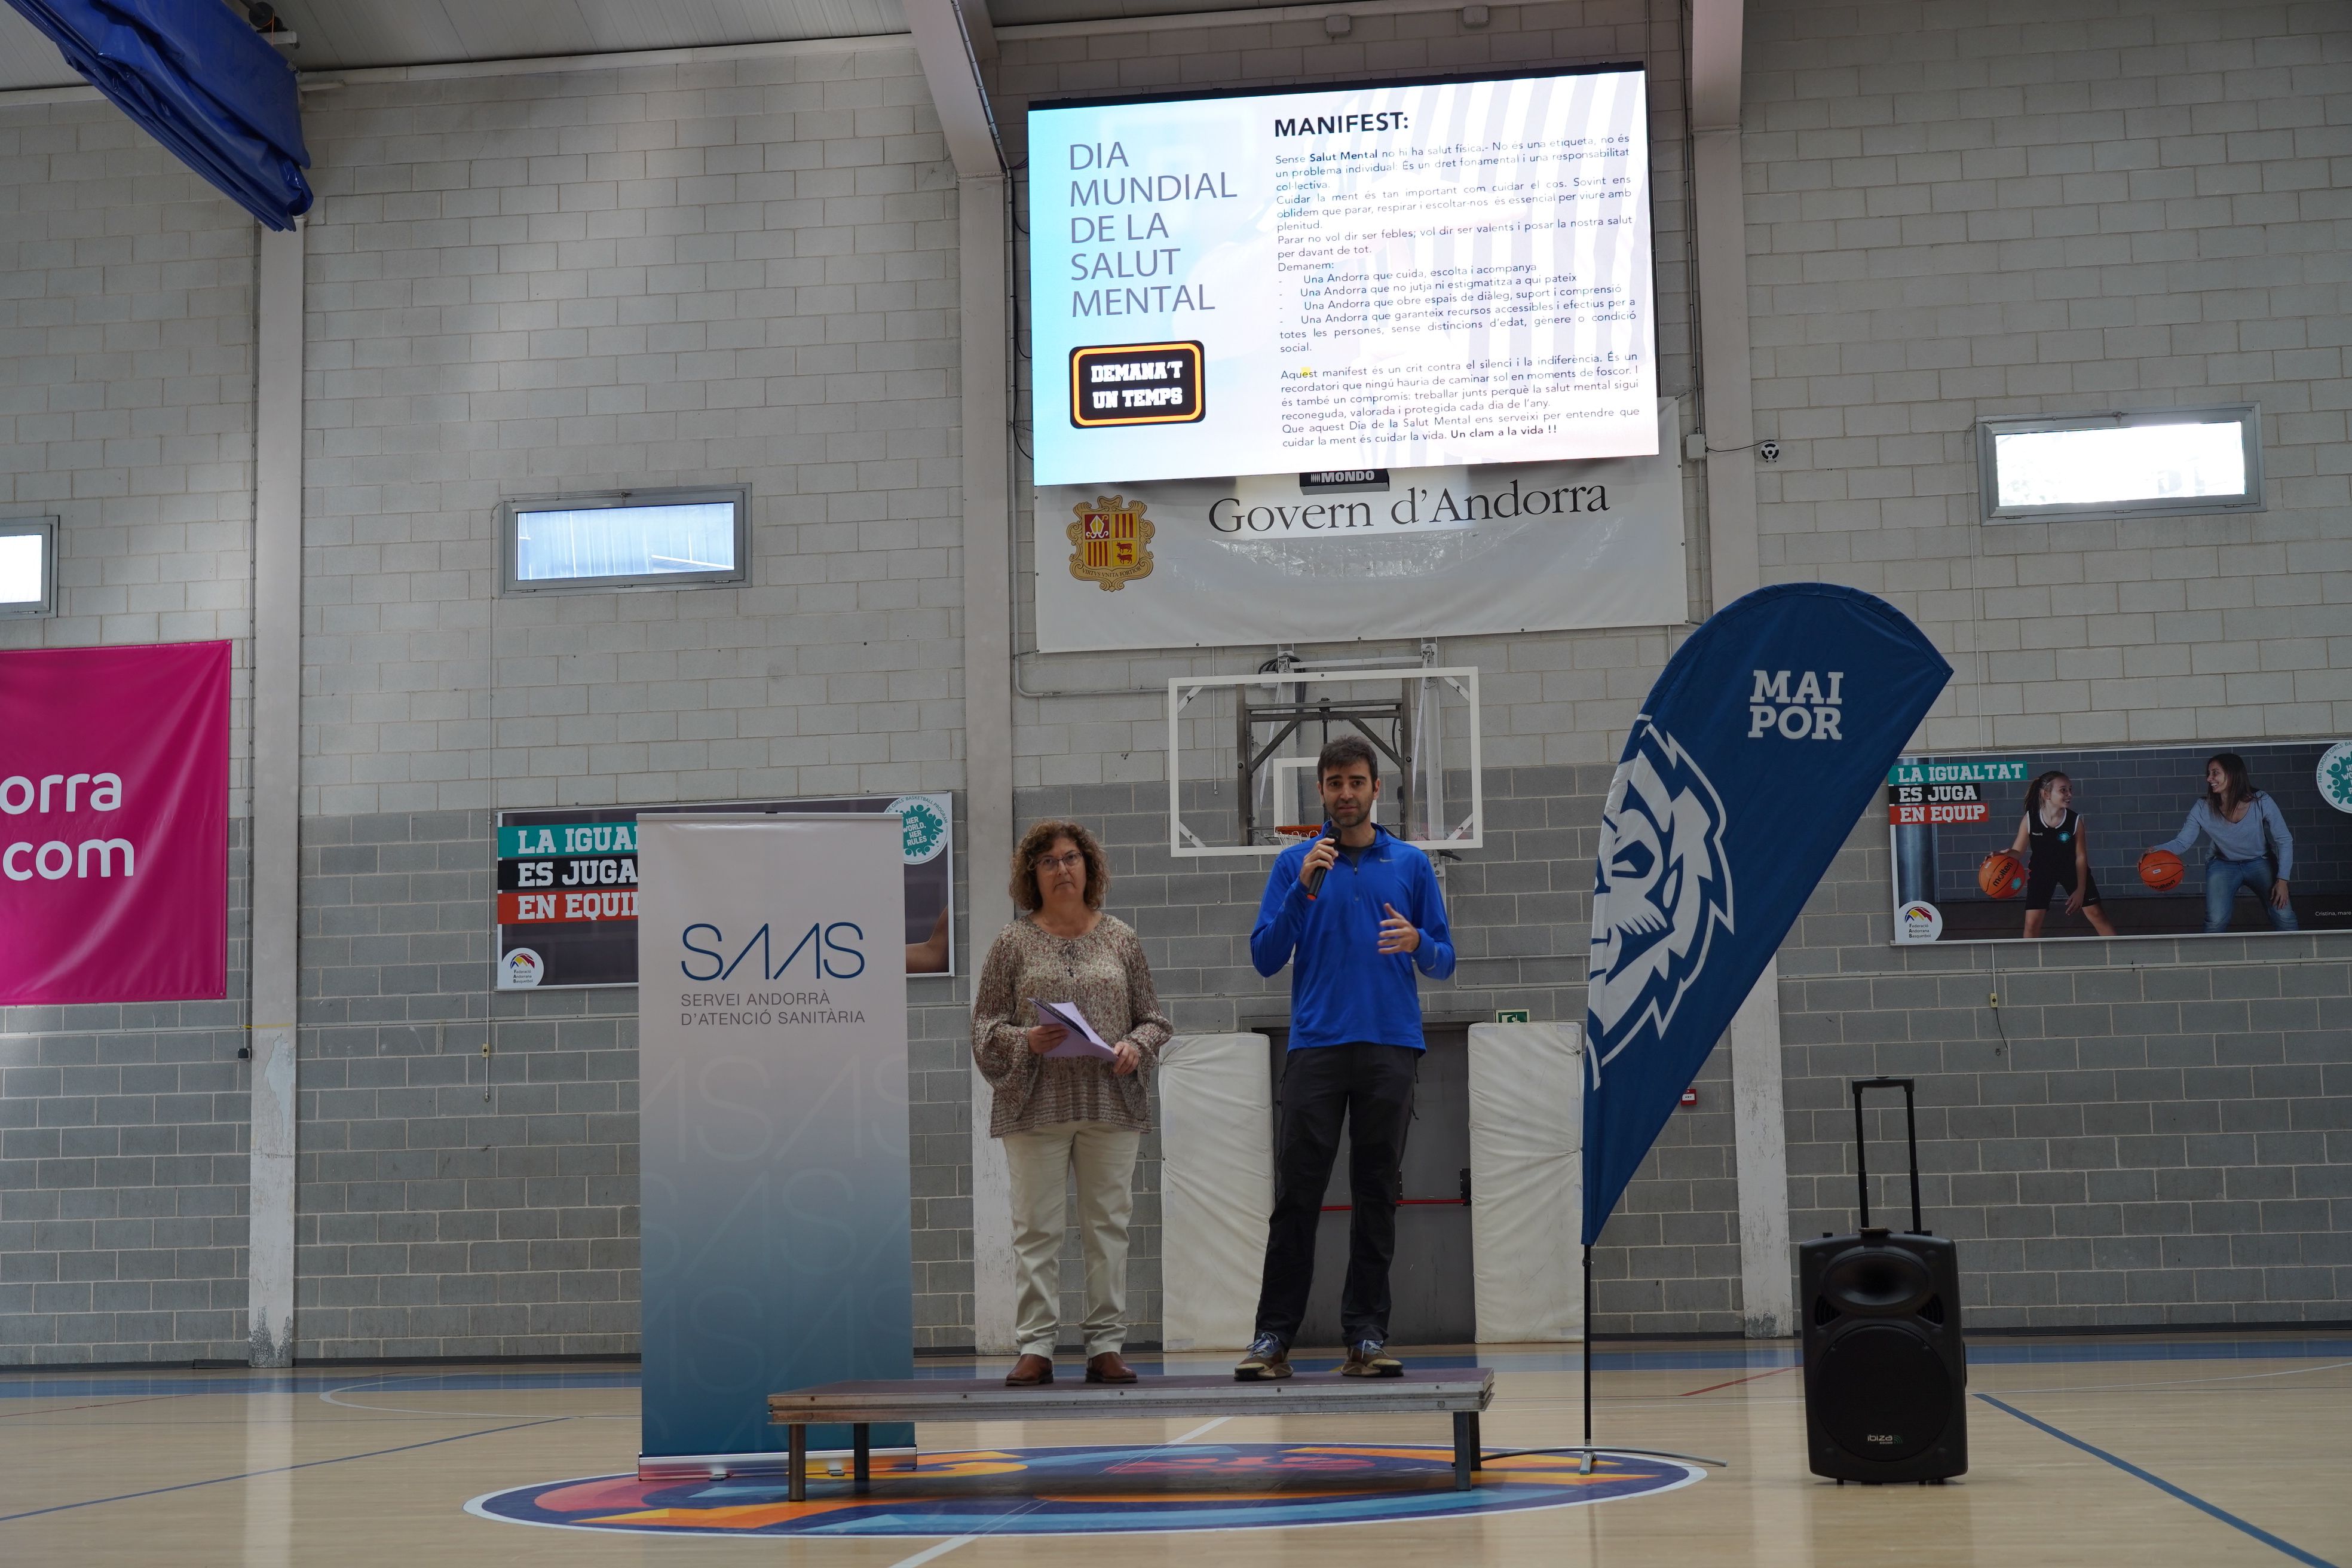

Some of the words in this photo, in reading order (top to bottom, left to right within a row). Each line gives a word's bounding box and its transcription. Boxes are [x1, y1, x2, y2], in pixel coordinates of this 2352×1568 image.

[1275, 112, 1408, 137] MANIFEST:
[1070, 142, 1129, 170] DIA
[1275, 155, 1306, 164] Sense
[1309, 152, 1337, 163] Salut
[1340, 148, 1378, 161] Mental
[1399, 148, 1407, 157] hi
[1411, 146, 1423, 156] ha
[1428, 145, 1452, 155] salut
[1492, 141, 1508, 151] No
[1512, 141, 1524, 149] és
[1549, 137, 1596, 149] etiqueta,
[1618, 133, 1630, 143] és
[1290, 166, 1342, 179] problema
[1346, 162, 1398, 174] individual:
[1402, 160, 1414, 170] És
[1435, 159, 1457, 168] dret
[1459, 154, 1520, 167] fonamental
[1552, 147, 1630, 163] responsabilitat
[1071, 172, 1237, 207] MUNDIAL
[1071, 215, 1115, 243] DE
[1128, 212, 1169, 240] LA
[1277, 219, 1322, 234] plenitud.
[1071, 248, 1181, 280] SALUT
[1278, 251, 1296, 261] per
[1298, 247, 1334, 257] davant
[1337, 245, 1350, 255] de
[1353, 246, 1372, 254] tot.
[1278, 262, 1334, 272] Demanem:
[1303, 274, 1324, 284] Una
[1327, 272, 1370, 283] Andorra
[1373, 273, 1393, 282] que
[1396, 268, 1426, 278] cuida,
[1430, 266, 1468, 277] escolta
[1477, 264, 1537, 275] acompanya
[1073, 284, 1215, 317] MENTAL
[1304, 301, 1324, 311] Una
[1327, 298, 1370, 310] Andorra
[1374, 299, 1394, 309] que
[1396, 296, 1421, 305] obre
[1425, 293, 1457, 307] espais
[1460, 292, 1474, 302] de
[1477, 290, 1512, 302] diàleg,
[1515, 289, 1550, 301] suport
[1560, 284, 1622, 297] comprensió
[1279, 330, 1307, 339] totes
[1313, 327, 1327, 337] les
[1334, 327, 1384, 339] persones,
[1428, 320, 1483, 331] distincions
[1490, 316, 1527, 327] d'edat,
[1534, 316, 1572, 327] gènere
[1591, 310, 1637, 321] condició
[1280, 342, 1312, 353] social.
[1091, 361, 1183, 382] DEMANA'T
[1092, 391, 1118, 409] UN
[1122, 387, 1183, 407] TEMPS
[1281, 397, 1293, 407] és
[1296, 395, 1330, 406] també
[1350, 391, 1411, 405] compromís:
[1414, 388, 1459, 400] treballar
[1462, 388, 1487, 400] junts
[1491, 384, 1529, 399] perquè
[1533, 384, 1542, 394] la
[1545, 382, 1570, 393] salut
[1574, 379, 1610, 391] mental
[1614, 378, 1639, 391] sigui
[1282, 408, 1346, 421] reconeguda,
[1350, 405, 1395, 417] valorada
[1404, 402, 1456, 417] protegida
[1460, 401, 1484, 411] cada
[1488, 400, 1504, 410] dia
[1507, 399, 1520, 409] de
[1524, 398, 1550, 409] l'any.
[1282, 436, 1315, 447] cuidar
[1318, 436, 1327, 445] la
[1330, 436, 1356, 445] ment
[1359, 434, 1372, 443] és
[1374, 431, 1407, 443] cuidar
[1410, 431, 1419, 441] la
[1422, 430, 1447, 440] vida.
[1451, 429, 1466, 439] Un
[1469, 428, 1494, 438] clam
[1507, 426, 1517, 436] la
[1520, 424, 1544, 435] vida
[1321, 470, 1374, 483] MONDO
[1209, 498, 1374, 532] Govern
[1391, 479, 1610, 525] d'Andorra
[1119, 566, 1142, 577] FORTIOR
[1750, 670, 1844, 704] MAI
[1748, 705, 1842, 740] POR
[1898, 767, 1924, 782] LA
[1928, 764, 2023, 782] IGUALTAT
[2319, 754, 2330, 771] EUROPE
[0, 773, 122, 814] orra
[1899, 786, 1922, 803] ES
[1928, 785, 1977, 802] JUGA
[905, 795, 933, 804] BASKETBALL
[933, 803, 948, 823] PROGRAM
[906, 816, 918, 825] HER
[1900, 807, 1925, 822] EN
[1931, 805, 1986, 822] EQUIP
[517, 829, 556, 854] LA
[565, 826, 638, 852] IGUA
[903, 822, 926, 833] WORLD,
[909, 829, 922, 838] HER
[906, 836, 927, 846] RULES
[2, 838, 134, 881] com
[518, 862, 553, 887] ES
[562, 859, 638, 885] JUGA
[1993, 862, 2013, 887] molten
[518, 895, 556, 920] EN
[681, 922, 865, 981] SAAS
[681, 994, 740, 1006] SERVEI
[746, 989, 831, 1005] ANDORRÀ
[681, 1009, 771, 1025] D'ATENCIÓ
[778, 1008, 865, 1024] SANITÀRIA
